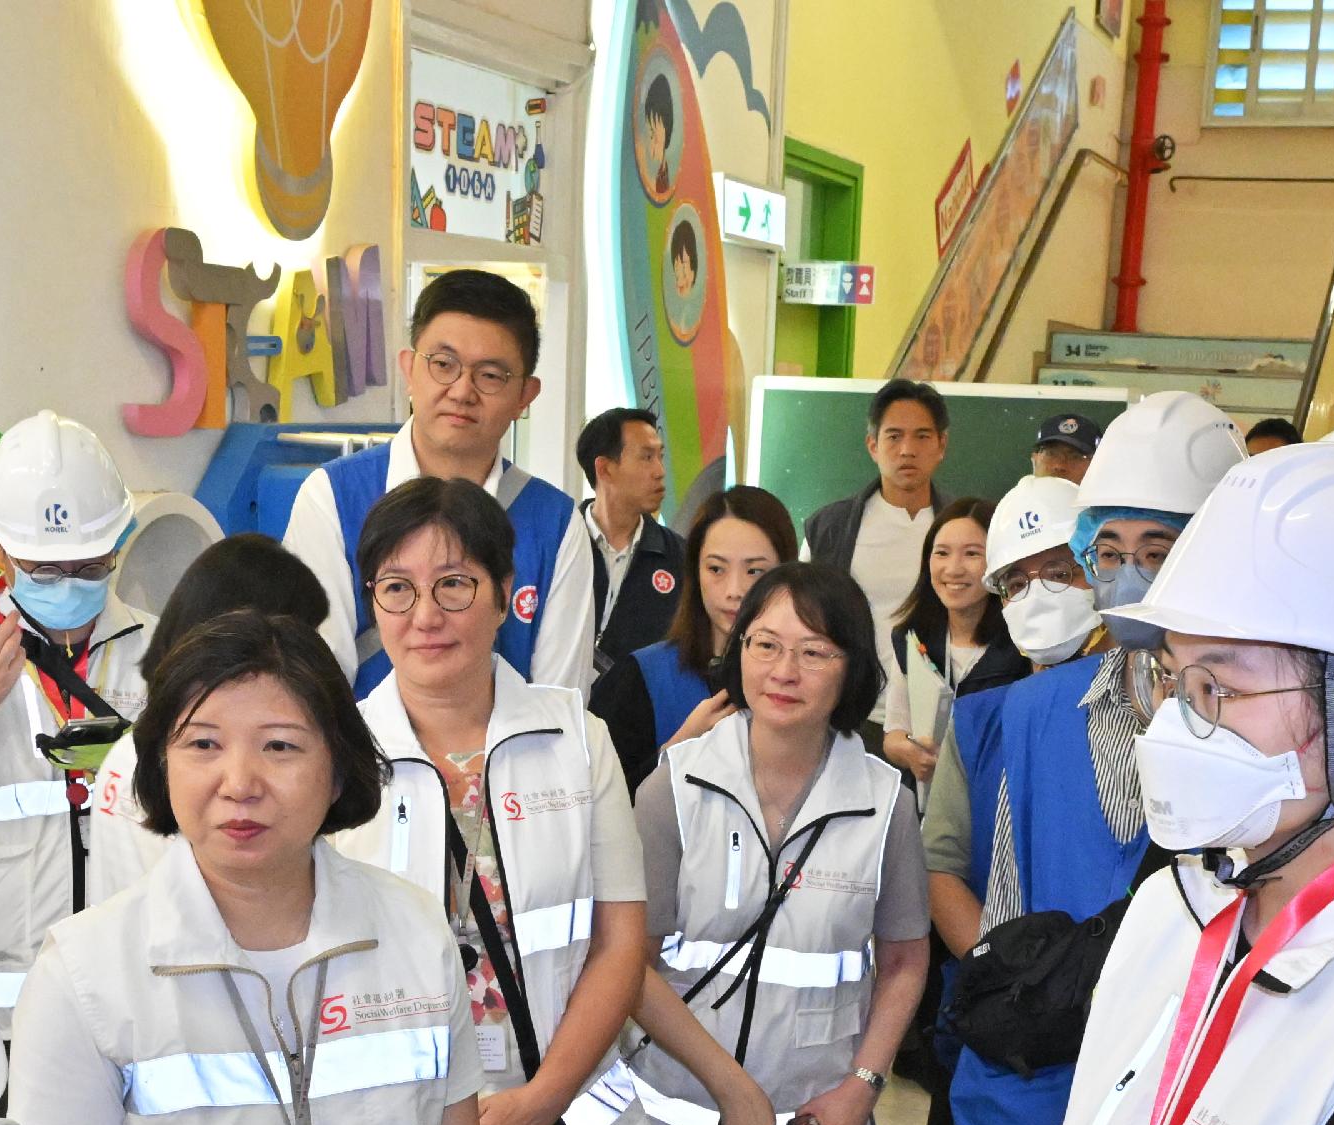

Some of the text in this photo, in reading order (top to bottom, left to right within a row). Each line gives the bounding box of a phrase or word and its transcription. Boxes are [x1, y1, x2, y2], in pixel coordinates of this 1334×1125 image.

[445, 164, 495, 200] 106A
[1065, 343, 1081, 358] 34
[354, 1008, 381, 1021] Social
[380, 1004, 412, 1018] Welfare
